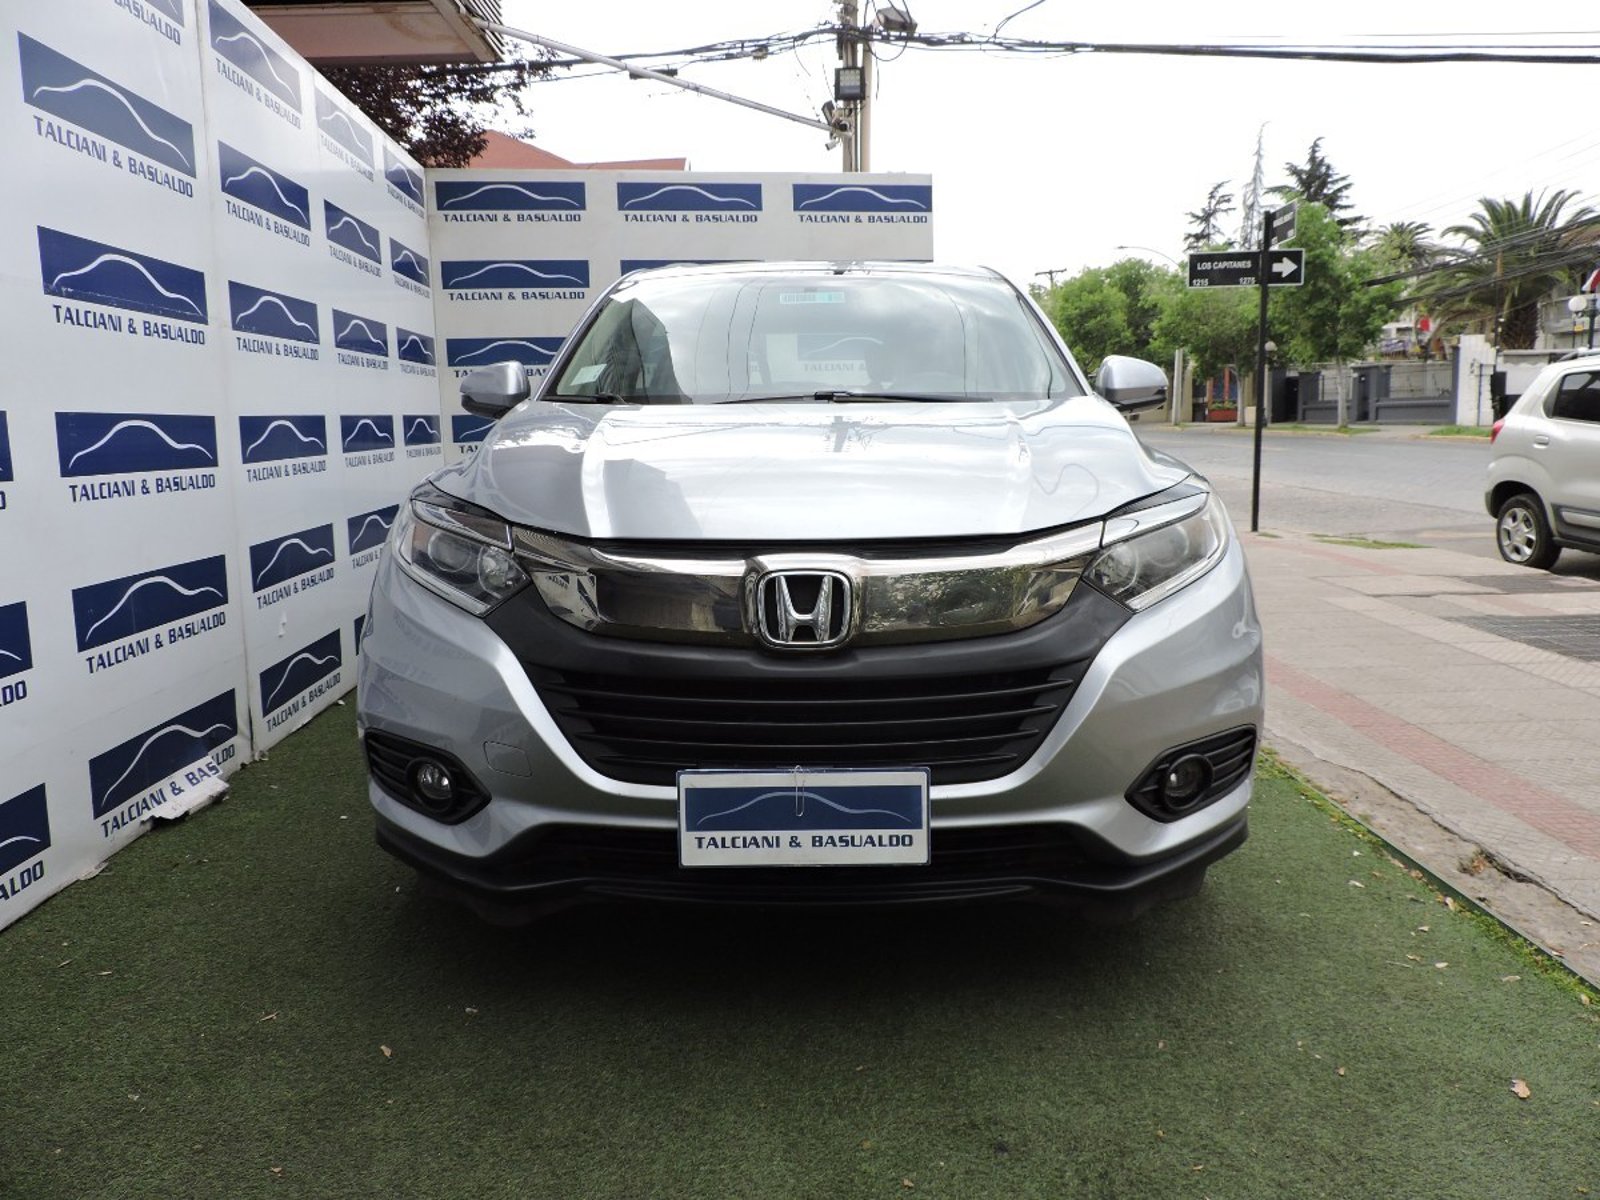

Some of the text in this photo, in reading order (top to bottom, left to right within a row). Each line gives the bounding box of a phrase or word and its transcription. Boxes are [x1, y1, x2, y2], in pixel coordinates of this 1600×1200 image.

[33, 115, 193, 198] TALCIANI & BASUALDO
[226, 200, 263, 228] TALCIANI
[265, 218, 271, 231] &
[443, 213, 582, 223] TALCIANI & BASUALDO
[624, 214, 758, 223] TALCIANI & BASUALDO
[799, 214, 928, 224] TALCIANI & BASUALDO
[1197, 260, 1251, 270] LOS CAPITANES
[448, 291, 585, 301] TALCIANI & BASUALDO
[53, 304, 206, 345] TALCIANI & BASUALDO
[236, 337, 273, 355] TALCIANI
[275, 343, 281, 355] &
[246, 464, 282, 483] TALCIANI
[284, 464, 290, 476] &
[69, 474, 216, 502] TALCIANI & BASUALDO
[257, 585, 291, 610] TALCIANI
[293, 582, 299, 594] &
[86, 611, 227, 674] TALCIANI & BASUALDO
[101, 788, 167, 838] TALCIANI
[170, 781, 185, 796] &
[694, 834, 914, 849] TALCIANI & BASUALDO
